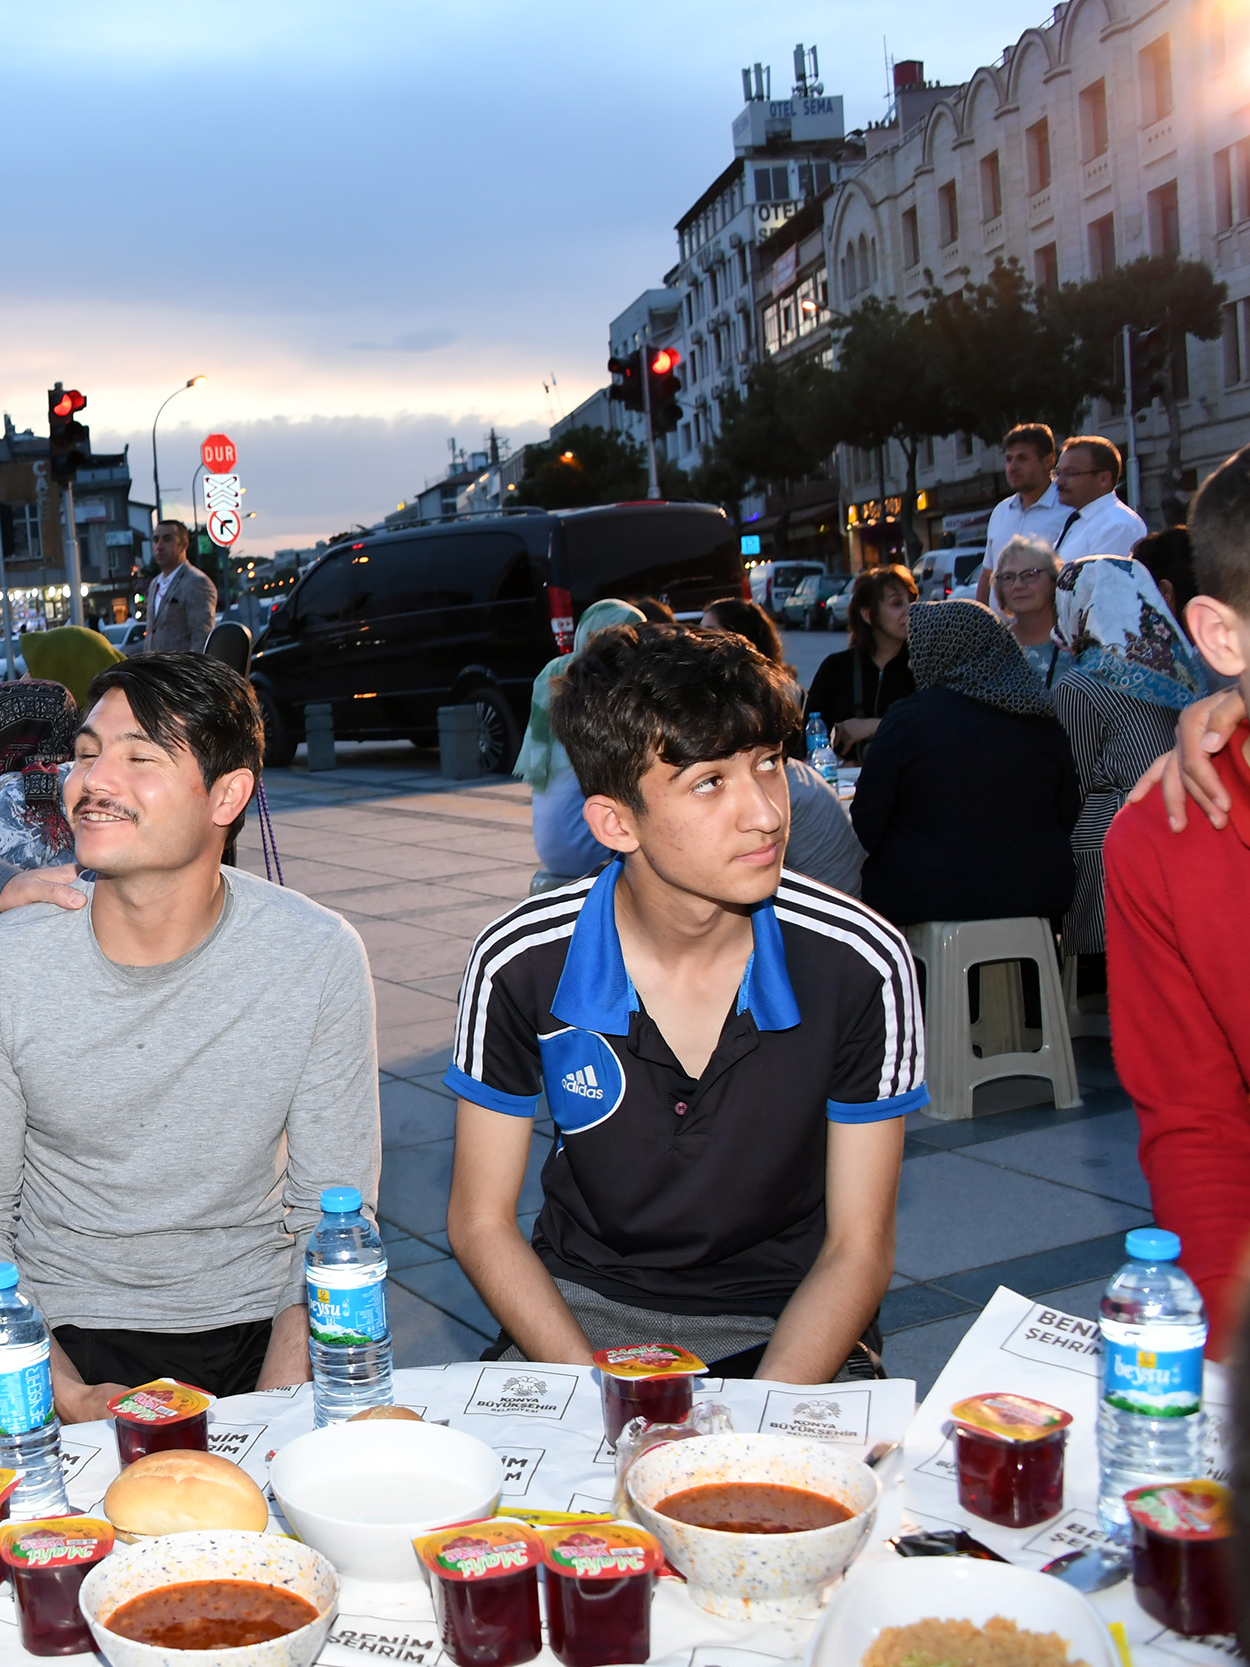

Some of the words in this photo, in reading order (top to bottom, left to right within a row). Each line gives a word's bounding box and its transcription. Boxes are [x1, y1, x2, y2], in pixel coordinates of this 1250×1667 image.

[769, 101, 796, 117] OTEL
[803, 98, 834, 116] SEMA
[204, 446, 234, 462] DUR
[561, 1078, 603, 1099] adidas
[1037, 1310, 1101, 1341] BENİ
[793, 1419, 836, 1429] KONYA
